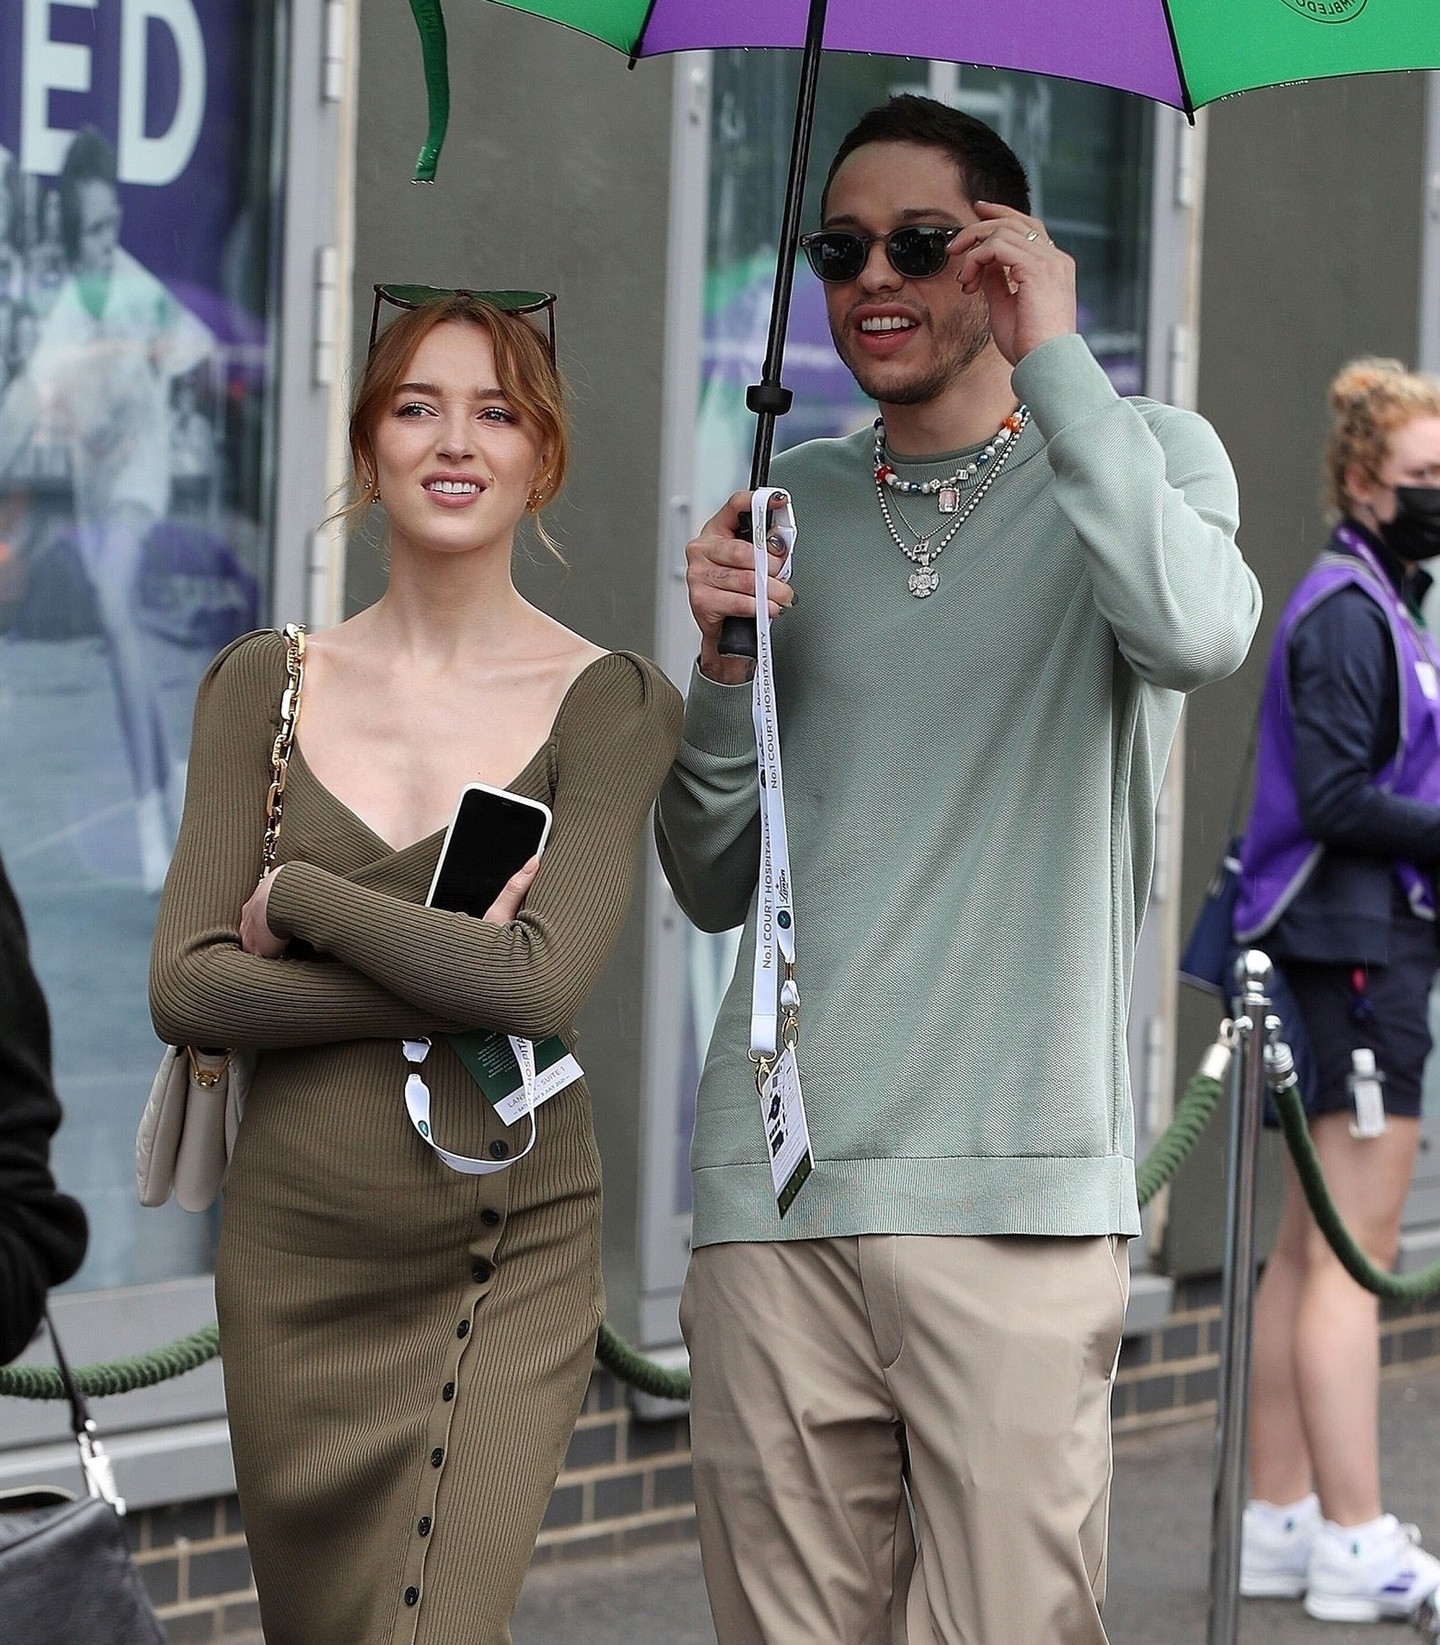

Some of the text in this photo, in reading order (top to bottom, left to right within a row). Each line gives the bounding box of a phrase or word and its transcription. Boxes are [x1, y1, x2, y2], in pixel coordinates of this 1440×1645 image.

[20, 0, 208, 187] ED
[760, 631, 778, 789] No.1 COURT HOSPITALITY
[779, 868, 789, 905] Lanson
[762, 897, 773, 942] COURT
[762, 944, 772, 970] No.1
[540, 1068, 561, 1086] SUITE
